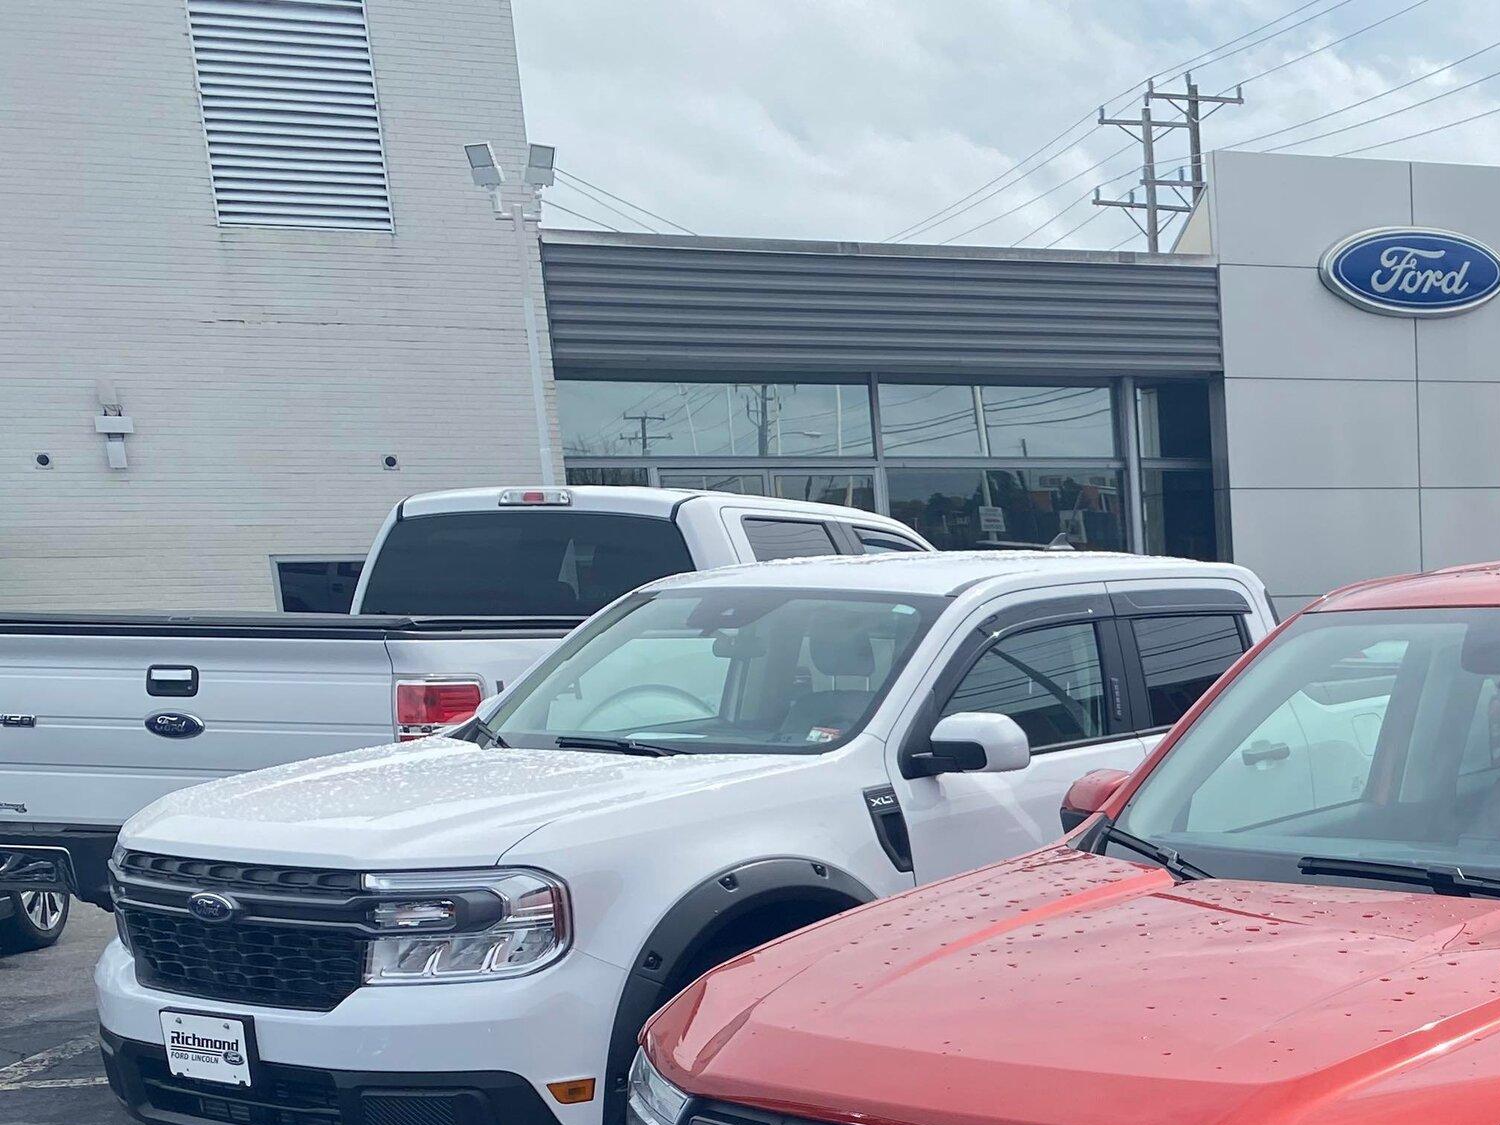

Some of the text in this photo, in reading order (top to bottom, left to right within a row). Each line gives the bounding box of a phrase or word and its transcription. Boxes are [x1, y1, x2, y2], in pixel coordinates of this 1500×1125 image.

[1370, 246, 1471, 296] Ford
[170, 1030, 239, 1052] Richmond
[170, 1051, 220, 1064] FORD LINCOLN
